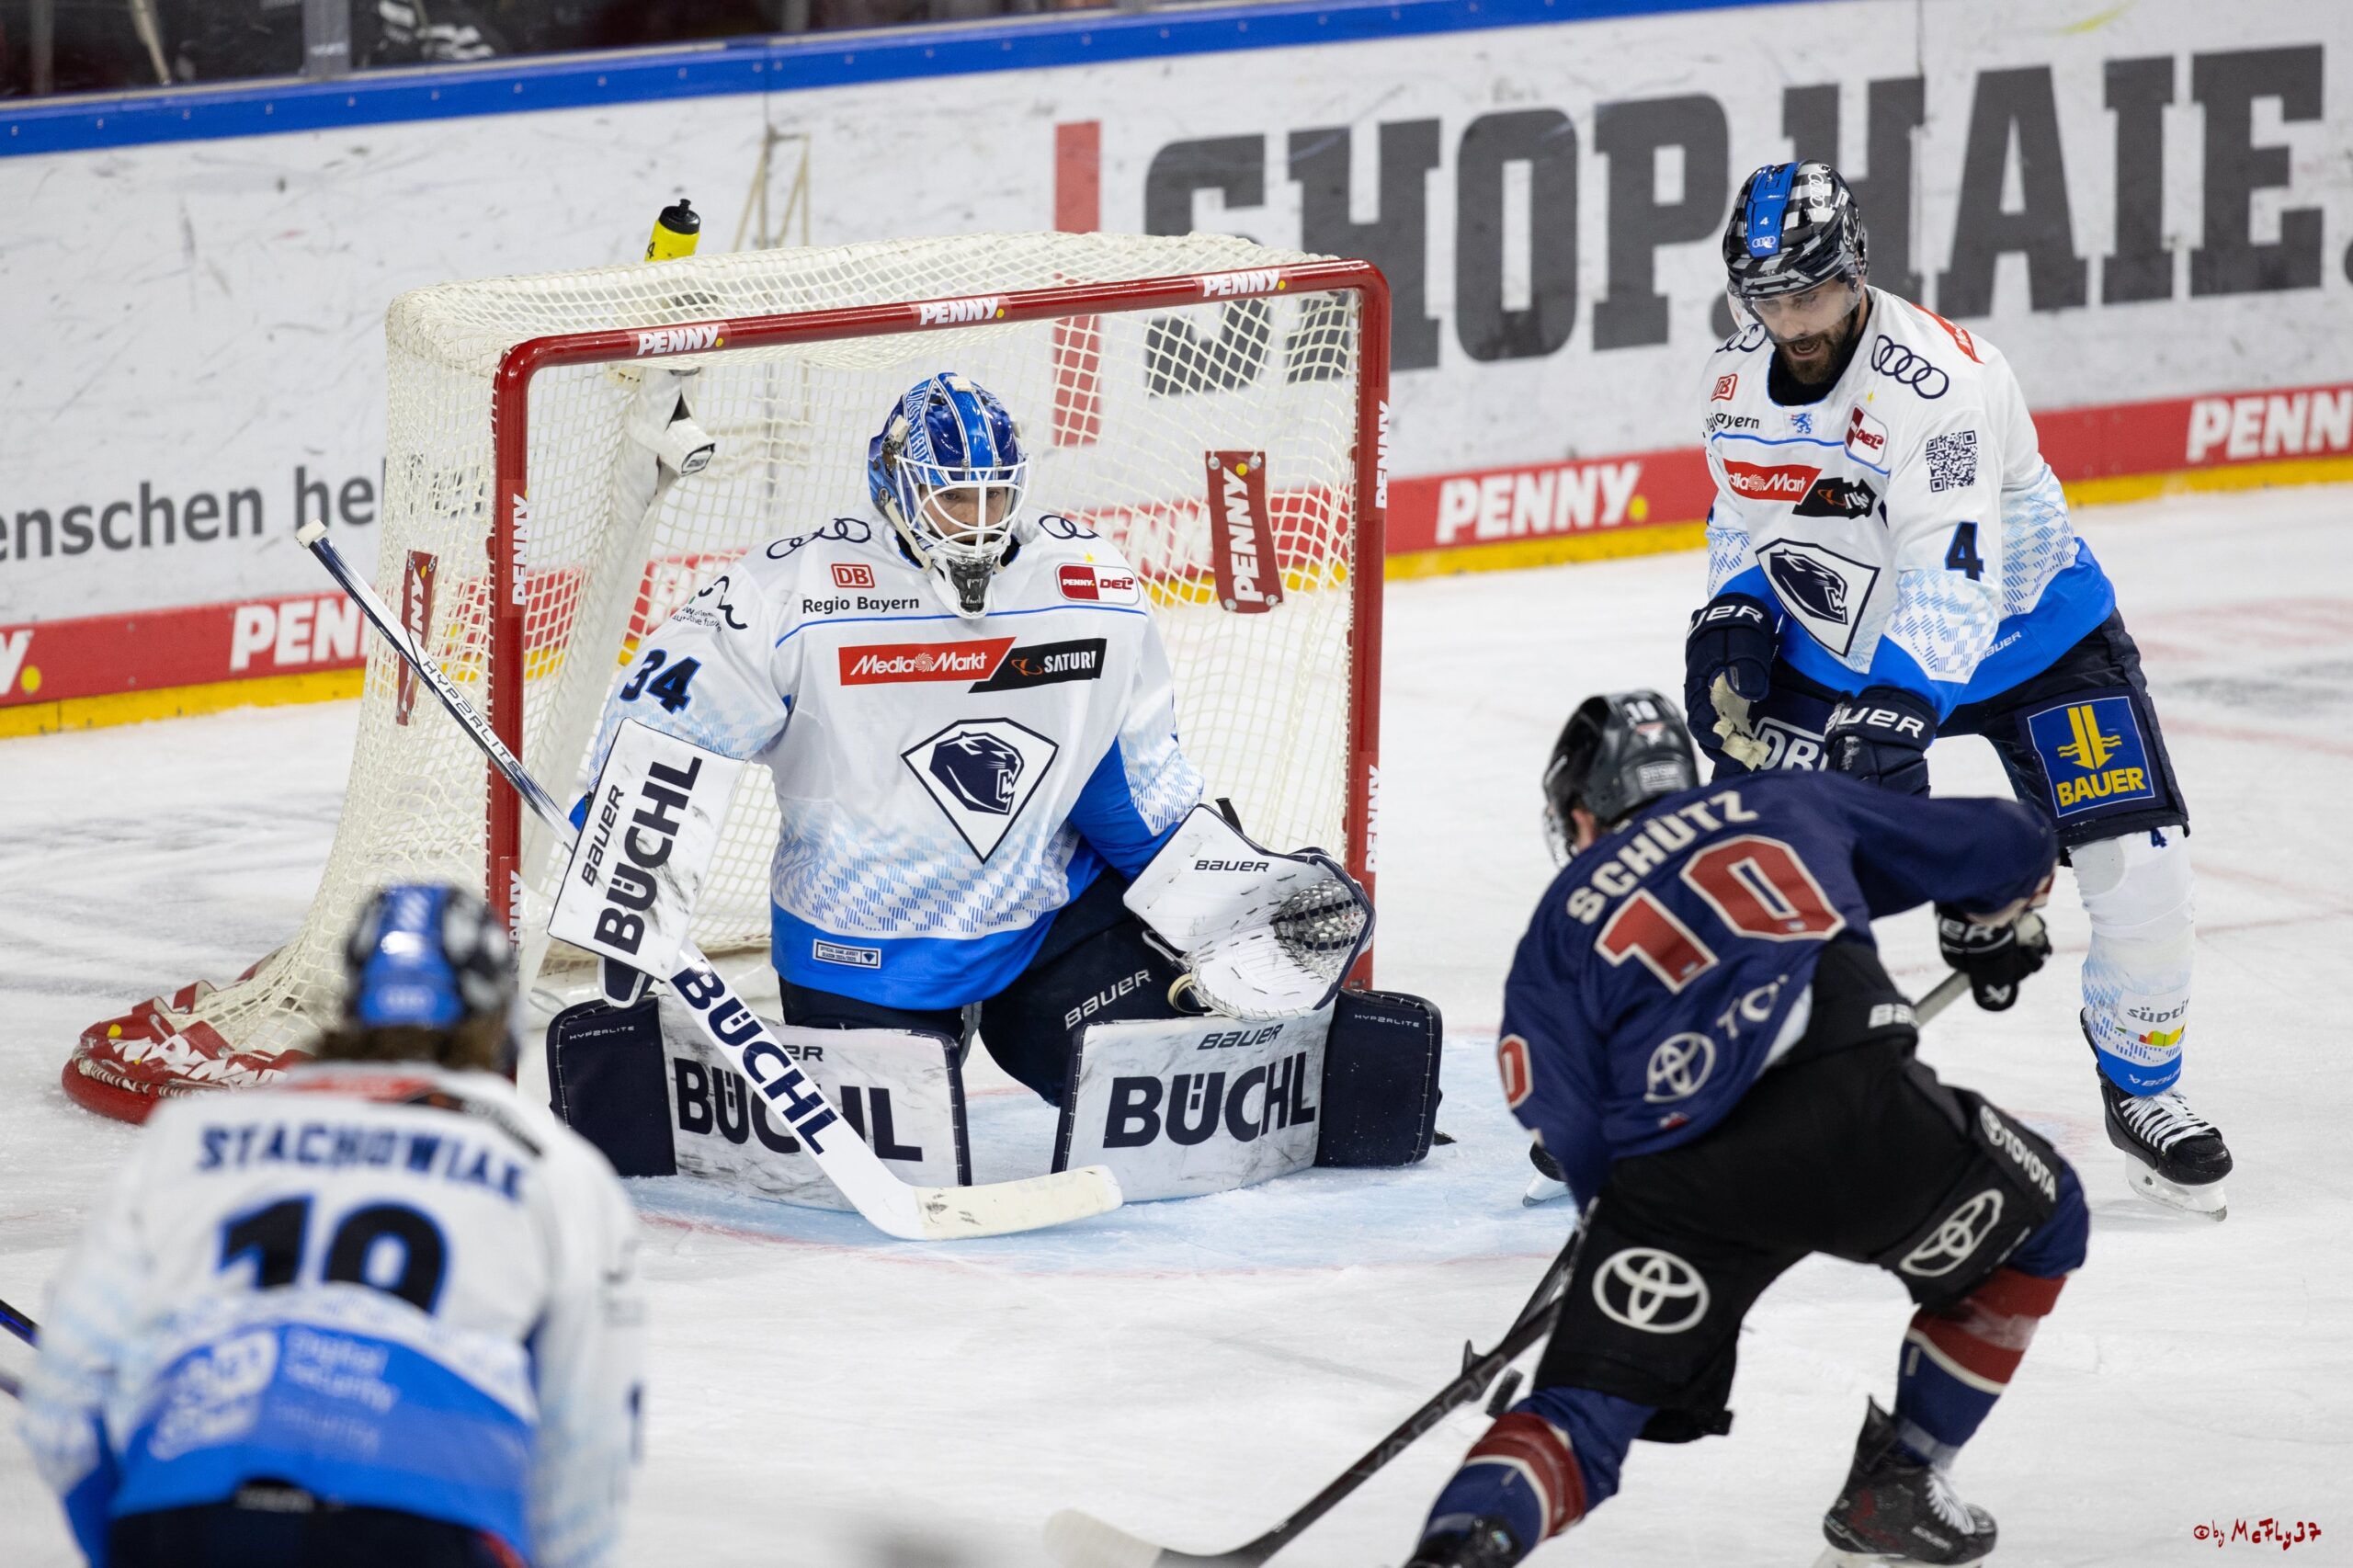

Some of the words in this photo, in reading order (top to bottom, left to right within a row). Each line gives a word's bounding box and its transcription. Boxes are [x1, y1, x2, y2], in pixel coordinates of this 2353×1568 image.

[1760, 217, 1769, 225] 4
[1203, 269, 1286, 299] PENNY.
[918, 297, 1005, 325] PENNY.
[636, 325, 724, 356] PENNY.
[1715, 412, 1760, 429] ayern
[0, 479, 264, 562] nschen
[1435, 461, 1648, 544] PENNY.
[1222, 462, 1265, 603] PENNY.
[1944, 521, 1984, 582] 4
[836, 567, 870, 585] DB
[1063, 578, 1096, 586] PENNY.
[1100, 577, 1134, 590] DEL
[802, 597, 850, 614] Regio
[857, 597, 919, 613] Bayern
[1978, 631, 2022, 661] AUER
[620, 649, 702, 715] 34
[2056, 767, 2147, 808] BAUER
[594, 756, 703, 956] BÜCHL
[1594, 833, 1847, 995] 10
[669, 965, 839, 1156] BÜCHL
[1102, 1051, 1316, 1149] BÜCHL
[2004, 1126, 2057, 1203] TOYOTA
